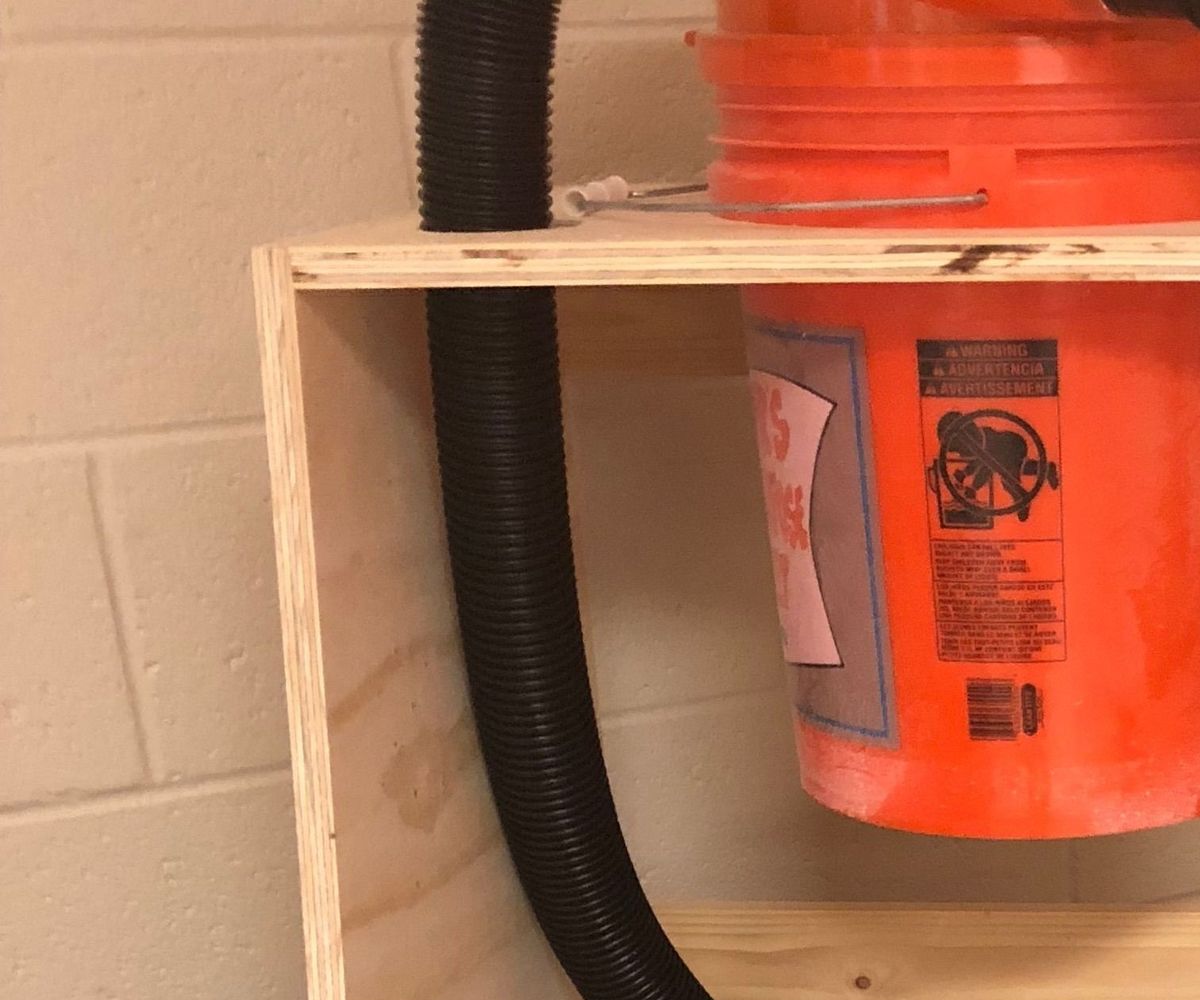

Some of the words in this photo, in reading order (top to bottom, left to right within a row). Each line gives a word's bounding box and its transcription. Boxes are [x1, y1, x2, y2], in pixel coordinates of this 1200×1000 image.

[959, 343, 1028, 357] WARNING
[949, 362, 1045, 376] ADVERTENCIA
[940, 382, 1054, 395] AVERTISSEMENT
